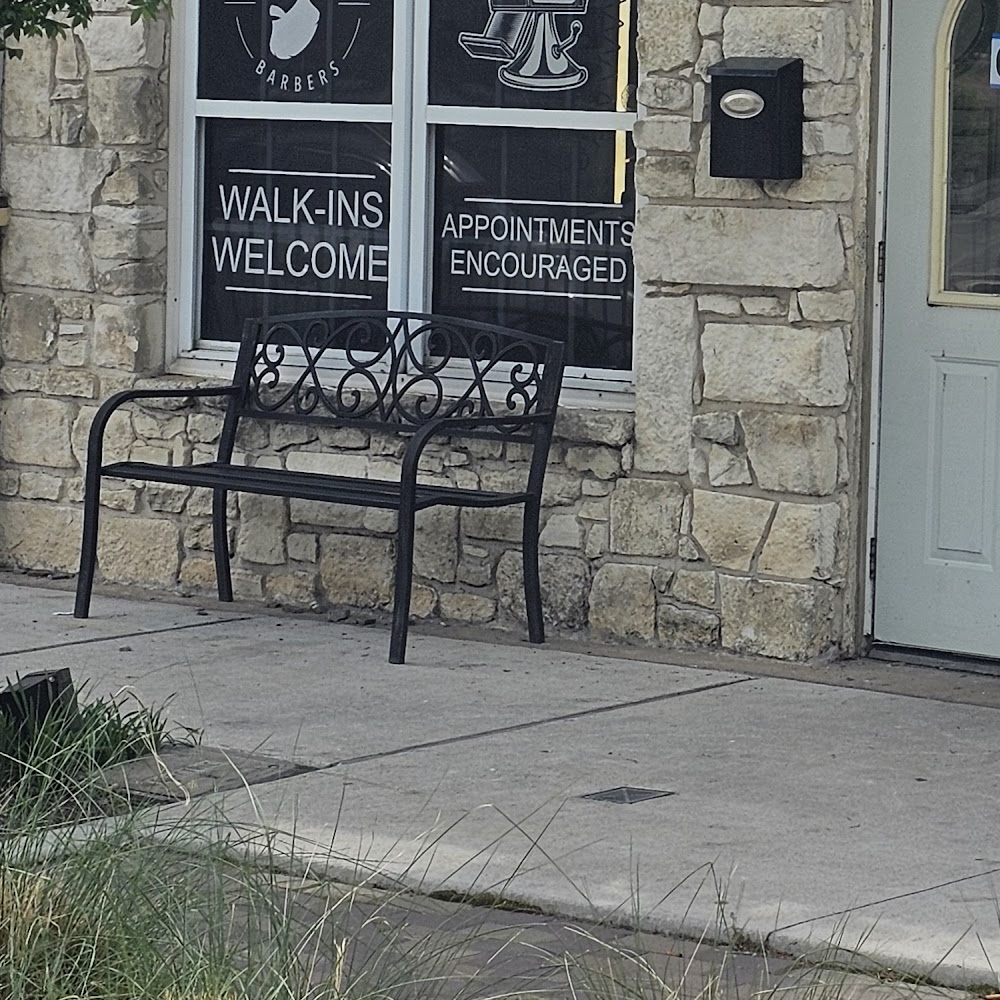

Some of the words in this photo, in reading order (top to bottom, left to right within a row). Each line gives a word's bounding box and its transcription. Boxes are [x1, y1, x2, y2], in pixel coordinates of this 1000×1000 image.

[255, 59, 341, 94] BARBERS
[219, 183, 384, 229] WALK-INS
[441, 213, 635, 247] APPOINTMENTS
[211, 235, 388, 282] WELCOME
[450, 249, 627, 283] ENCOURAGED
